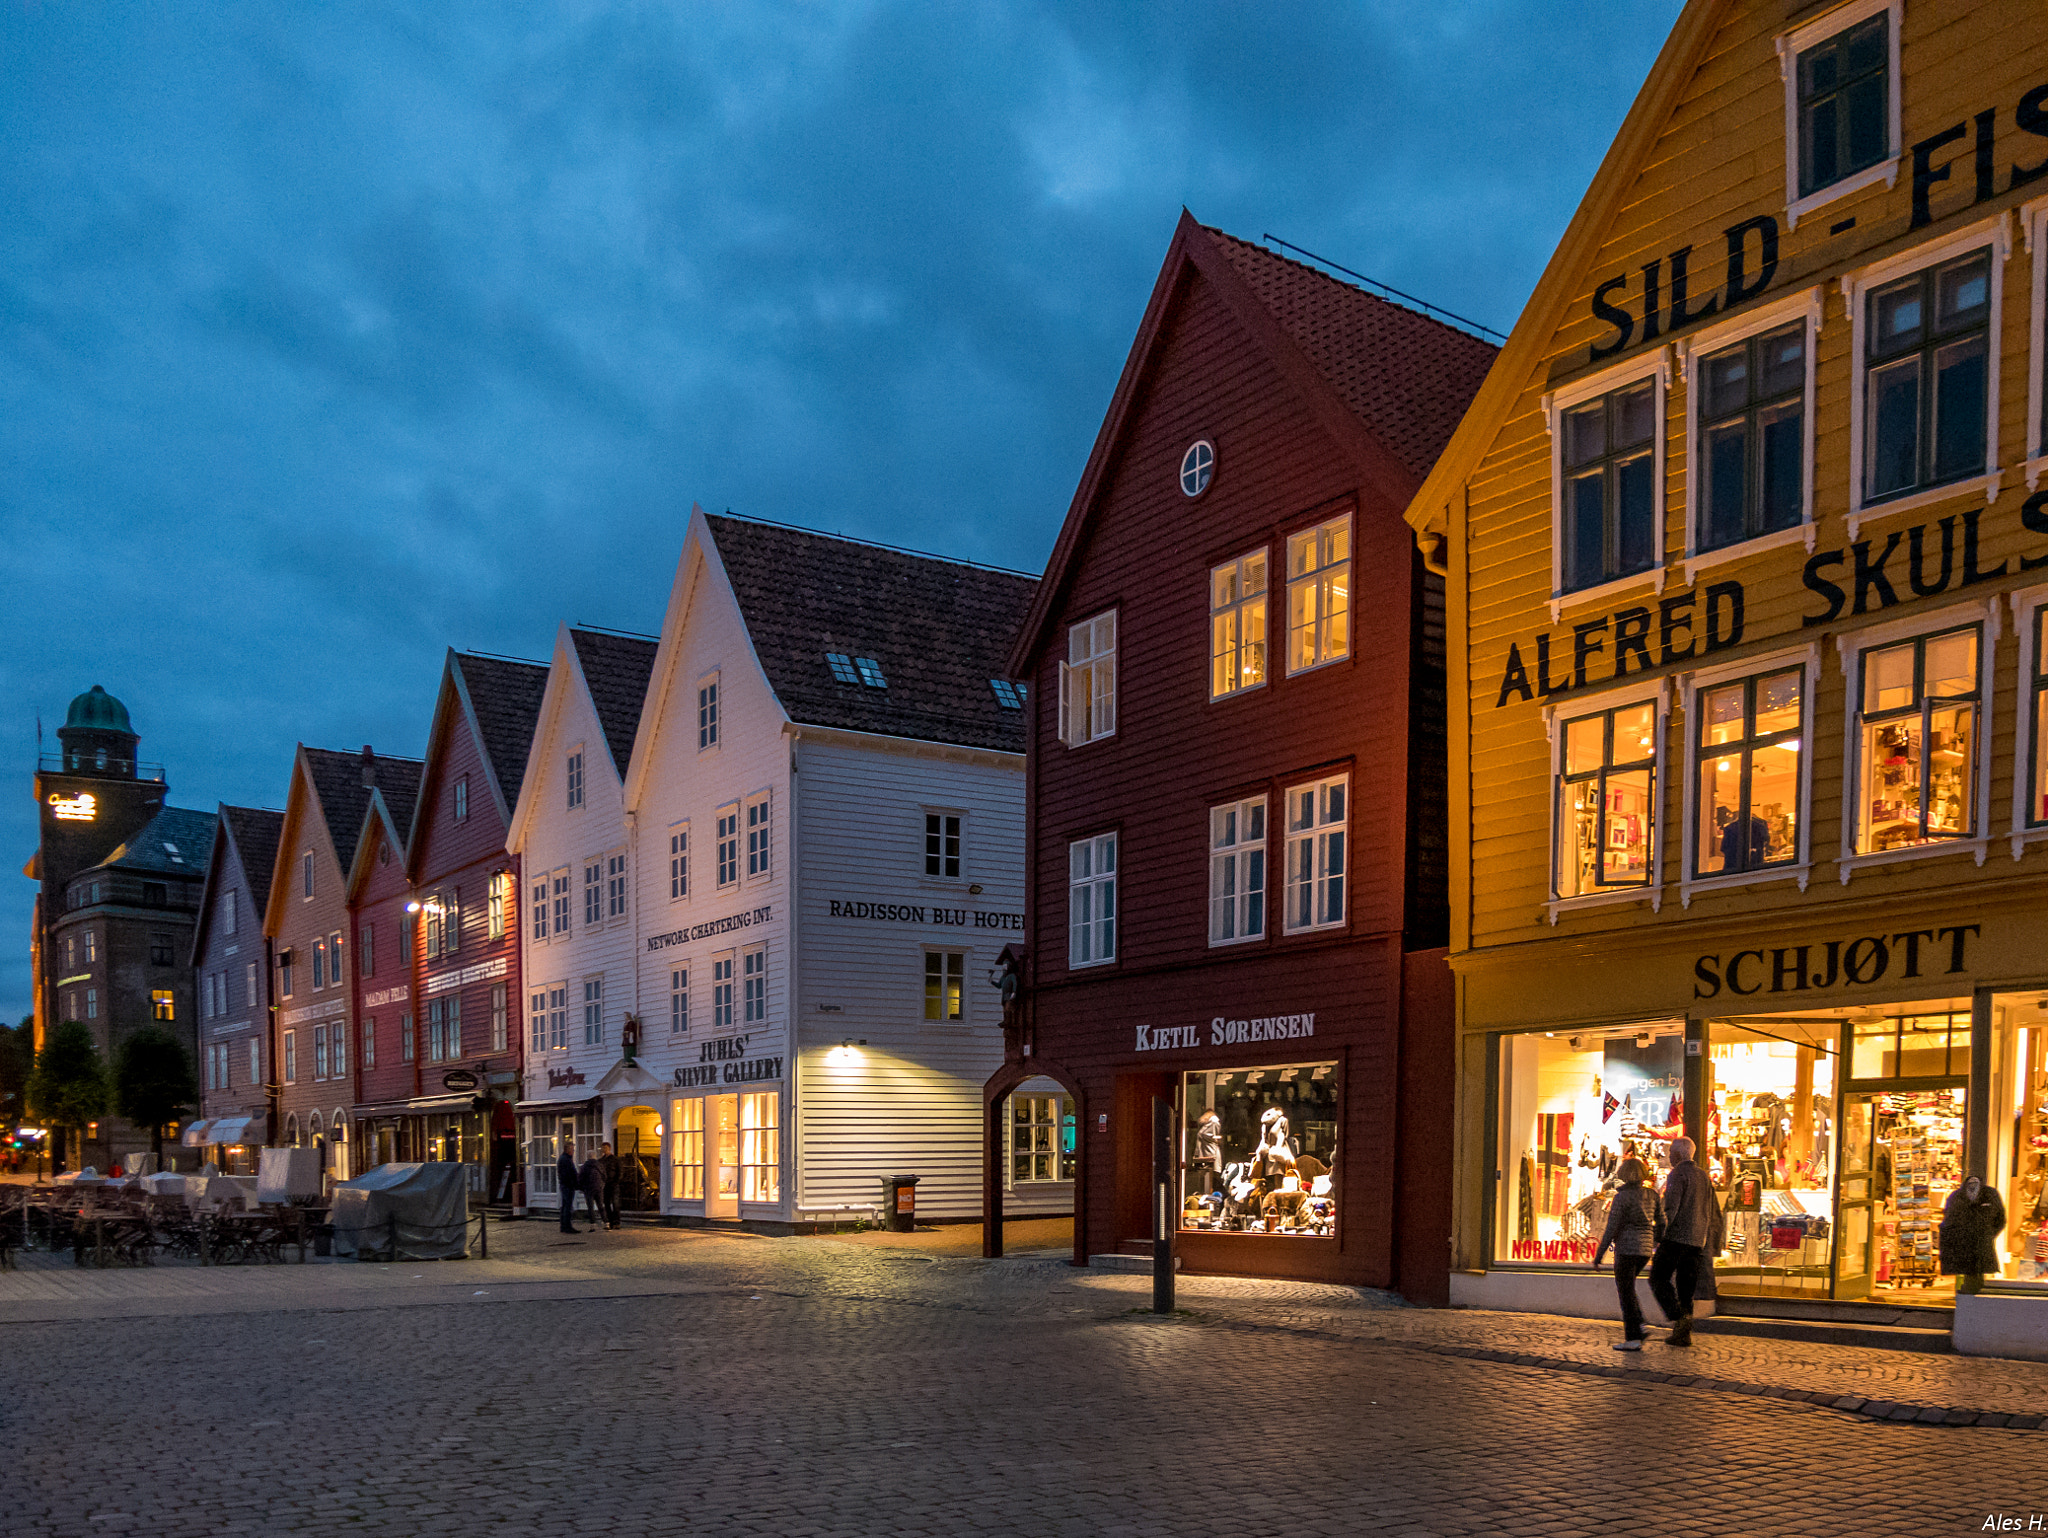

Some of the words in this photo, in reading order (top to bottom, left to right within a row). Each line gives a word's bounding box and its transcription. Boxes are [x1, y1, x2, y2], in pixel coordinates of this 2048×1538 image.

[1590, 214, 1779, 363] SILD
[1496, 580, 1745, 708] ALFRED
[647, 928, 689, 951] NETWORK
[690, 912, 751, 940] CHARTERING
[752, 906, 773, 925] INT.
[829, 900, 925, 922] RADISSON
[932, 908, 966, 926] BLU
[973, 911, 1025, 931] HOTE
[1694, 924, 1981, 1000] SCHJØTT
[674, 1064, 717, 1088] SILVER
[723, 1057, 783, 1083] GALLERY
[1512, 1240, 1578, 1261] NORWAY
